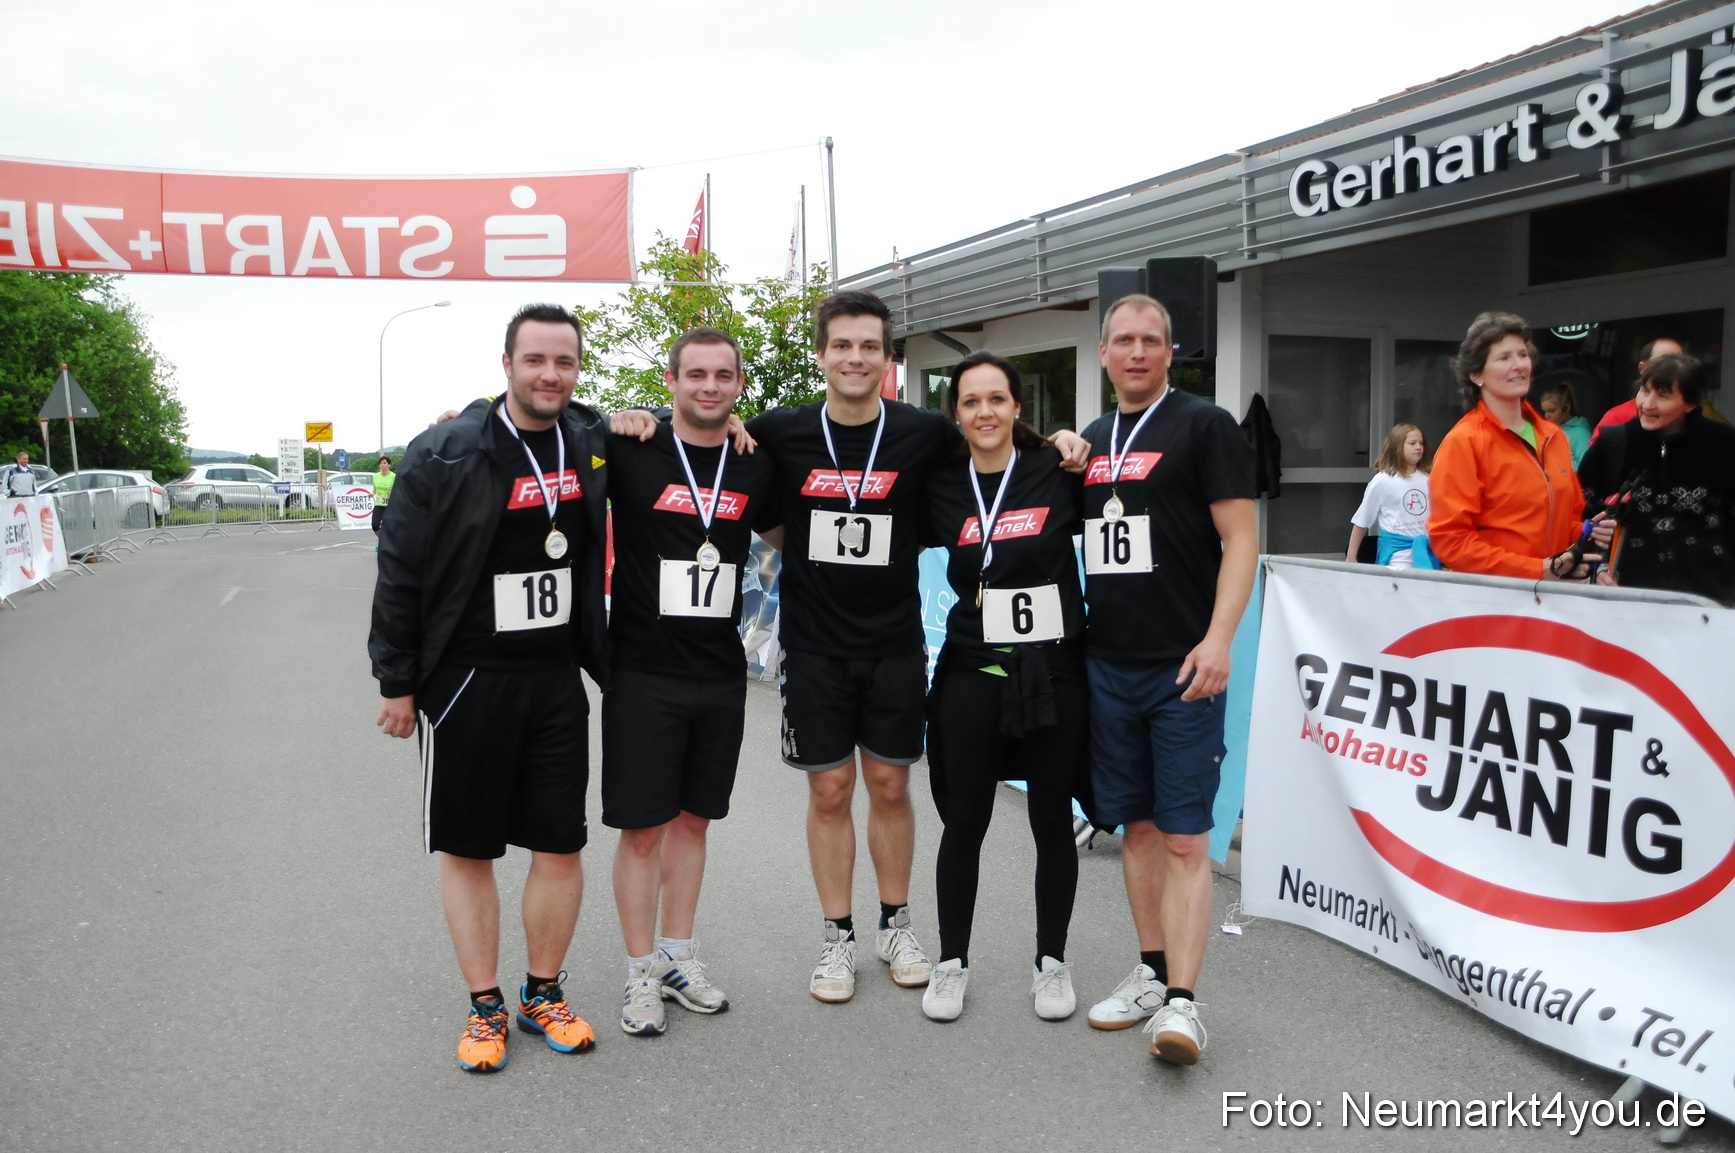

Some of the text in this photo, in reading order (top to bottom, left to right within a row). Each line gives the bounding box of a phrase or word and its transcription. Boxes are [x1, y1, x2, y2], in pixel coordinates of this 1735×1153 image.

[1288, 103, 1542, 217] Gerhart
[1566, 82, 1626, 150] &
[336, 496, 368, 504] GERHART
[1100, 520, 1130, 565] 16
[523, 573, 558, 621] 18
[686, 564, 720, 608] 17
[1011, 592, 1034, 635] 6
[1294, 653, 1670, 782] GERHART &
[1415, 751, 1683, 875] JÄNIG
[1278, 865, 1399, 943] Neumarkt
[1631, 1006, 1715, 1074] Tel.
